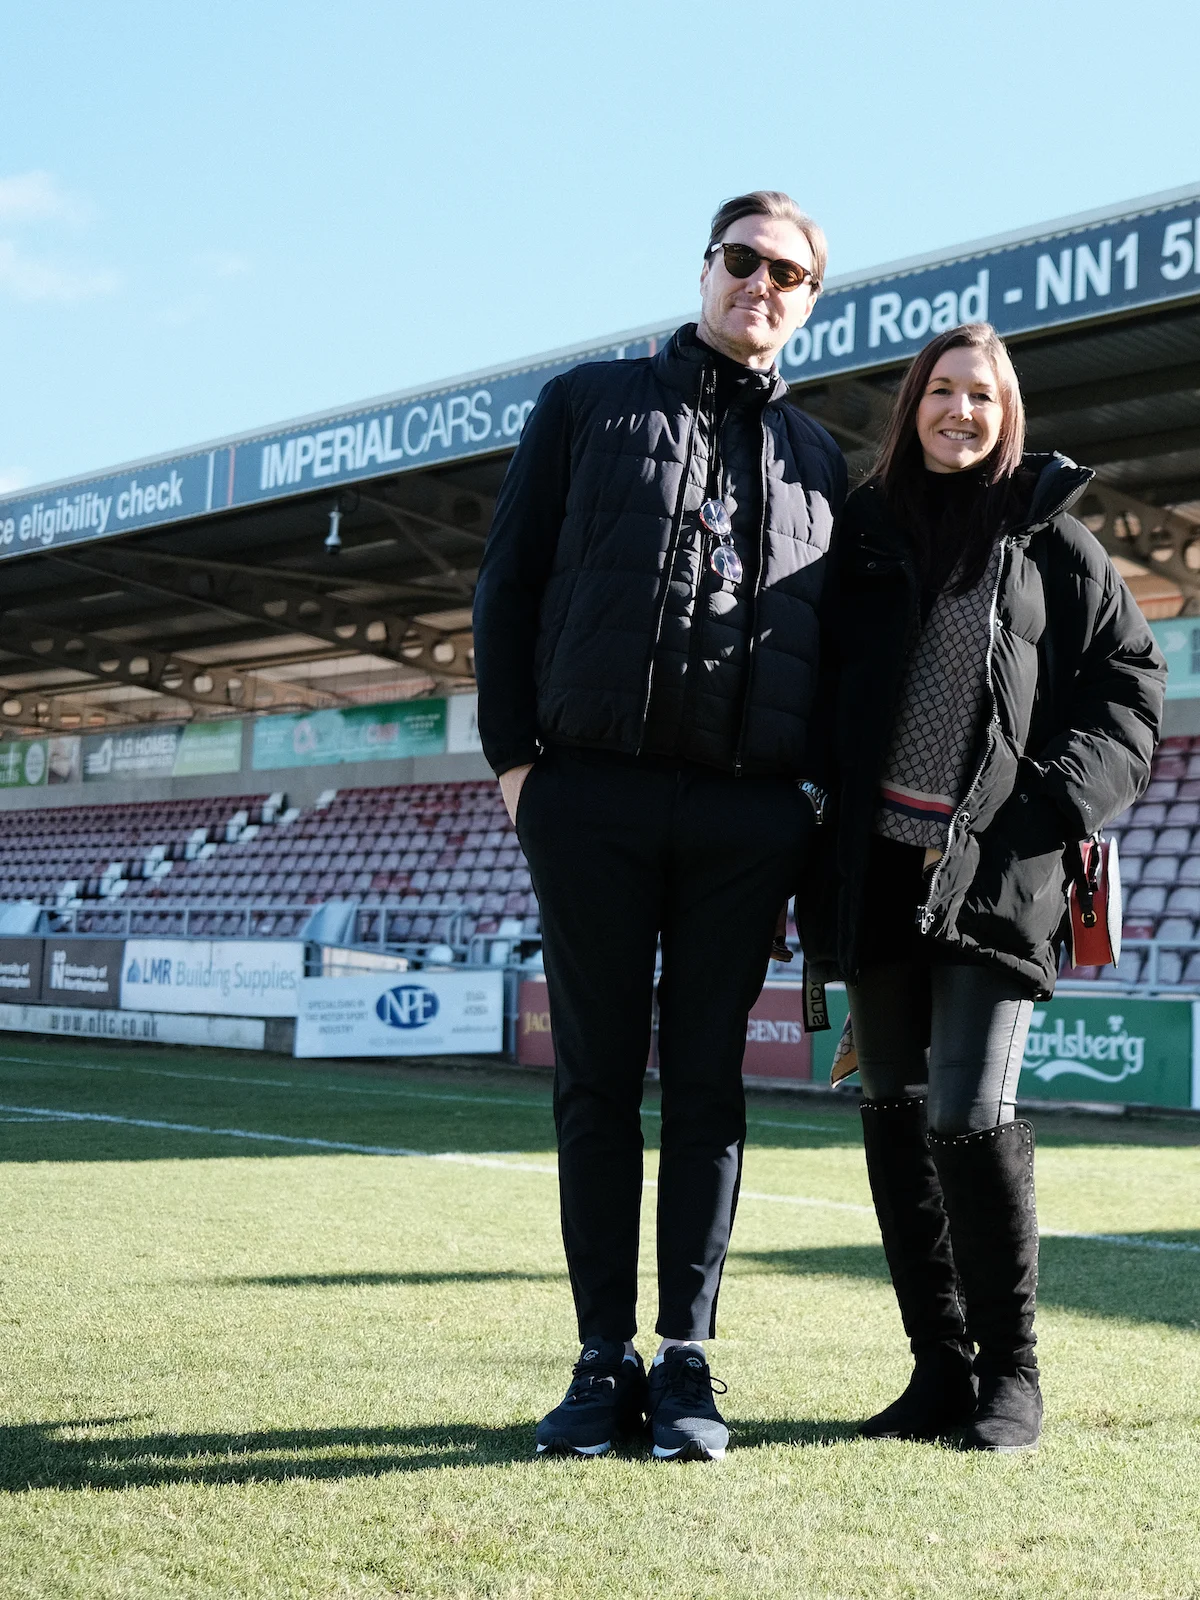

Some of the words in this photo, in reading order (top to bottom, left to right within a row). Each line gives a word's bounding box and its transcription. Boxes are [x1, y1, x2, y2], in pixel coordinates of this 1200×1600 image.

[775, 302, 857, 367] ord
[868, 268, 990, 348] Road
[1035, 231, 1139, 311] NN1
[19, 491, 112, 545] eligibility
[116, 469, 184, 521] check
[143, 958, 172, 985] LMR
[175, 960, 231, 997] Building
[233, 961, 297, 997] Supplies
